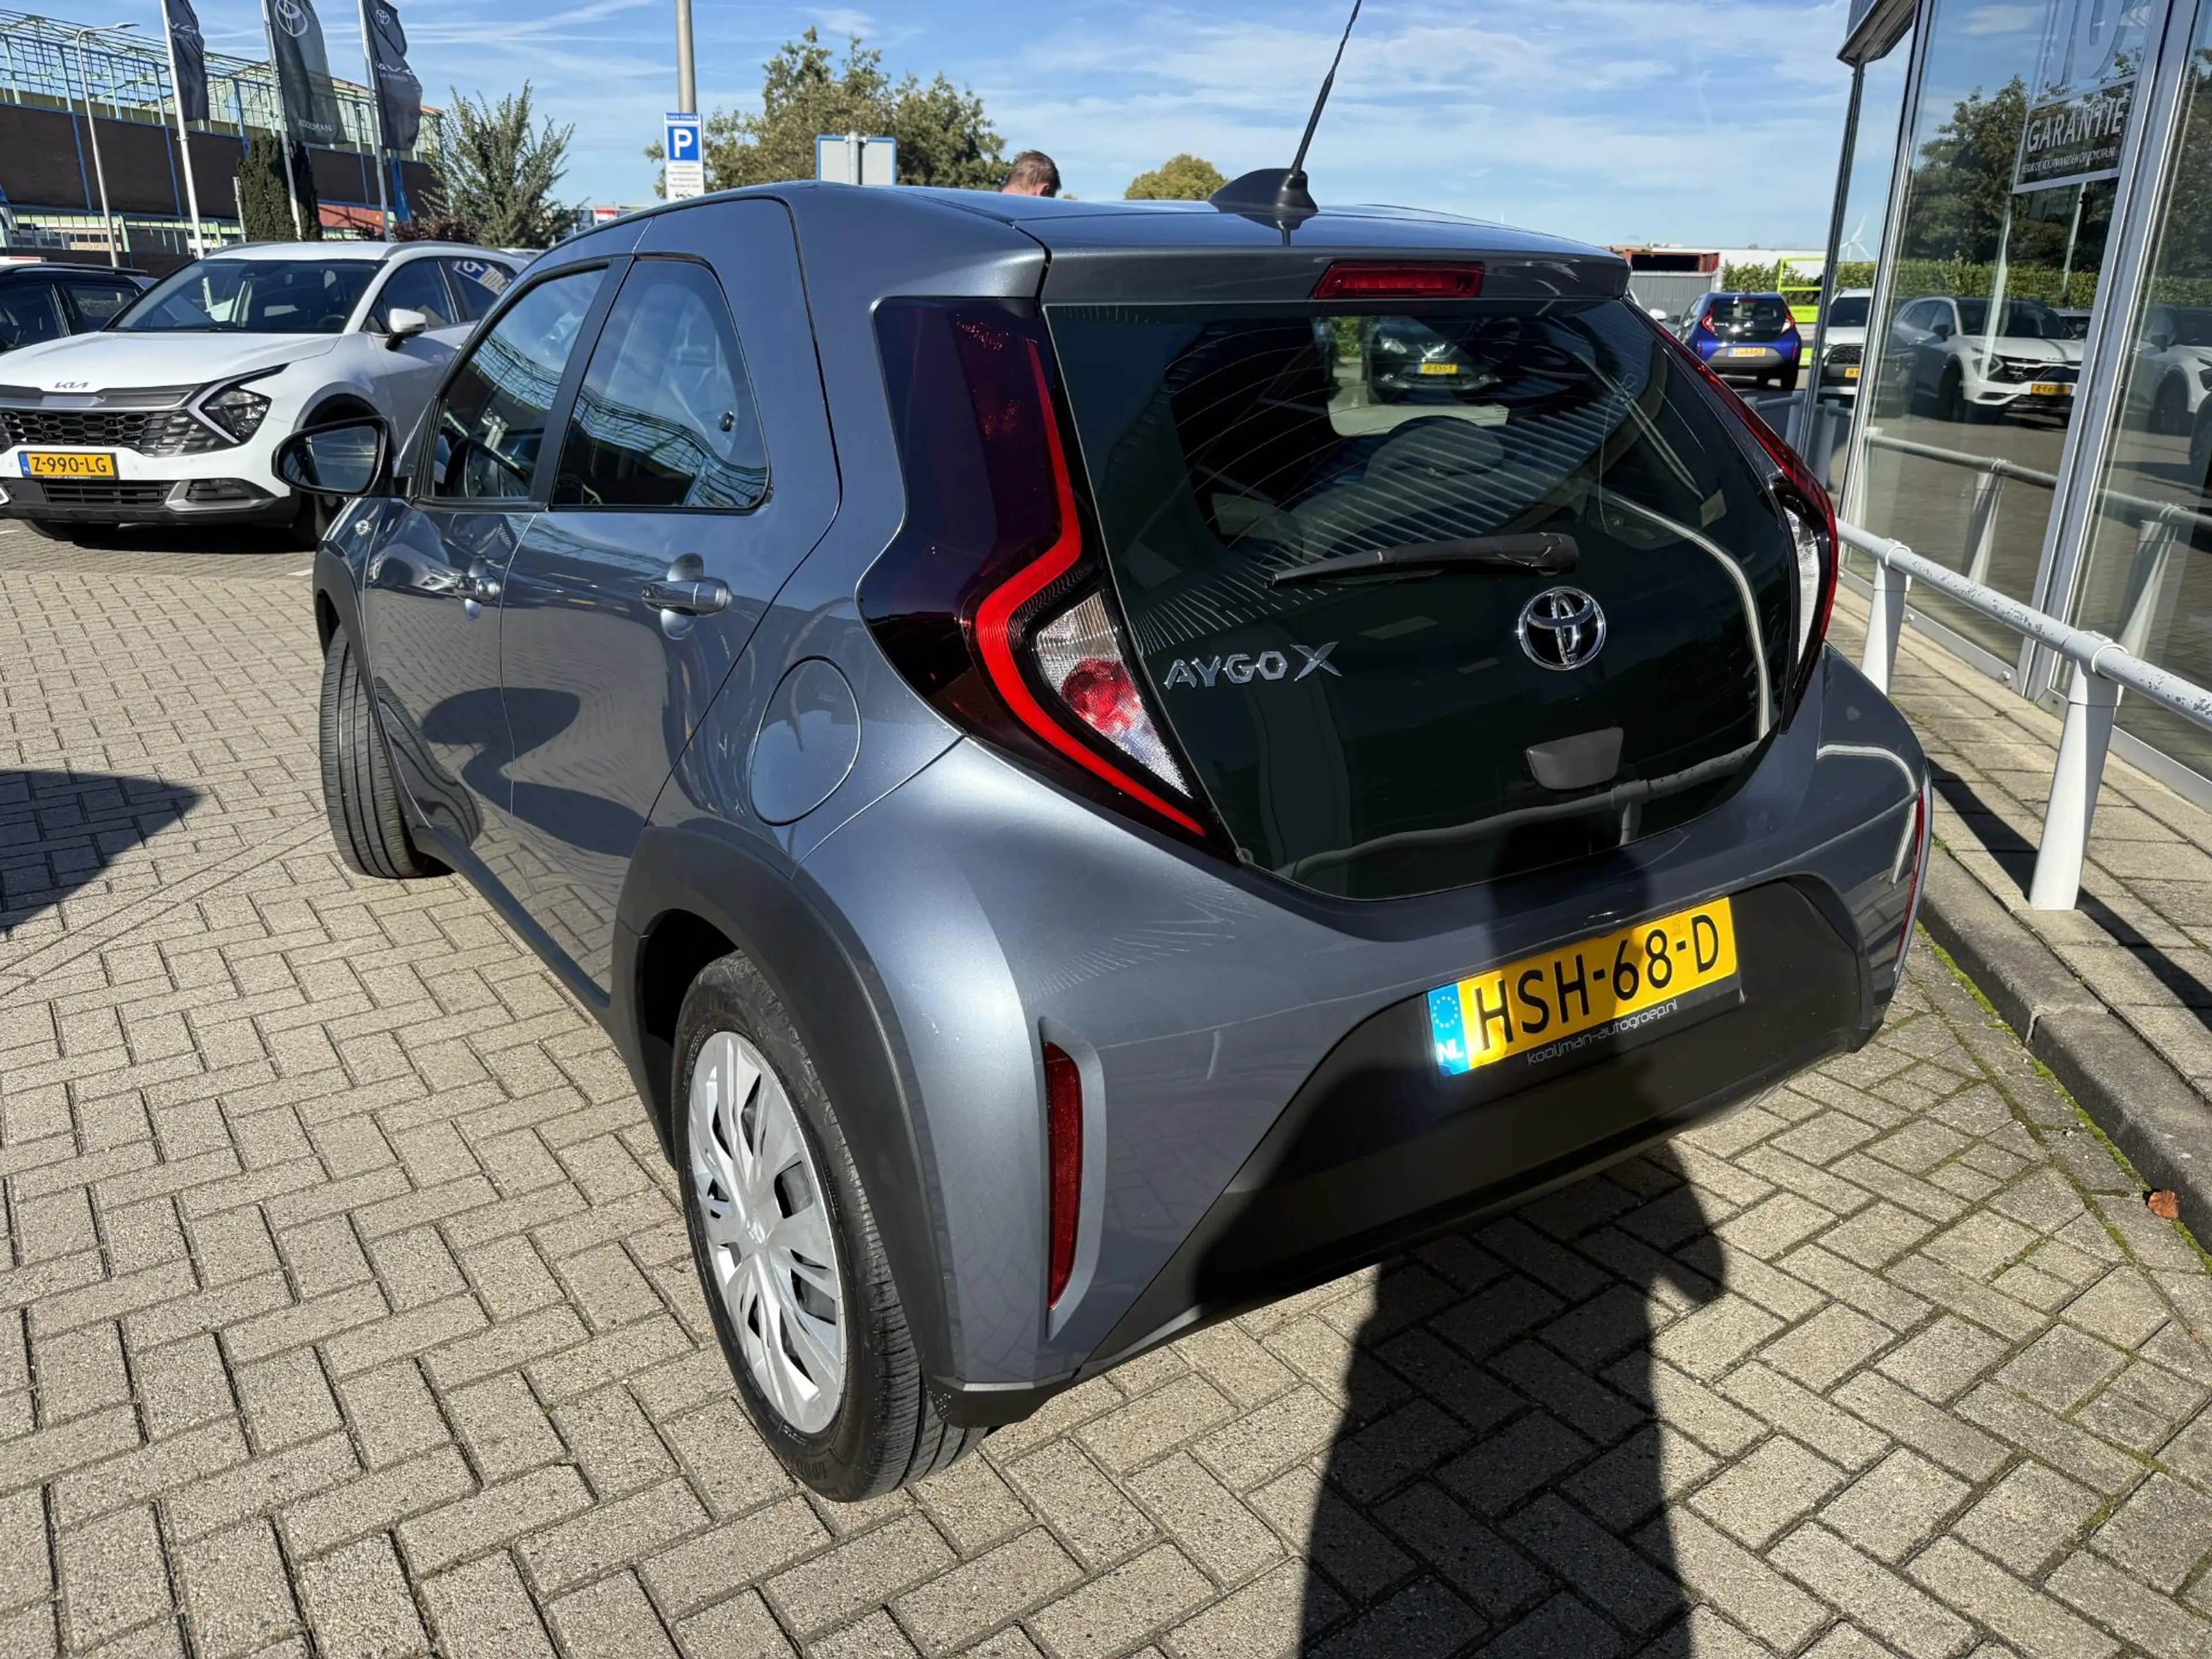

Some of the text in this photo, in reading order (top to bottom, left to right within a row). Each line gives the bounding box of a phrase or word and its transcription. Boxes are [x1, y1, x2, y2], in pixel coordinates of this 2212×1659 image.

[673, 128, 692, 158] P
[2027, 98, 2126, 153] GARANTIE
[32, 457, 107, 472] Z-990-LG
[1163, 641, 1343, 690] AYGO X
[1437, 914, 1719, 1061] NL HSH-68-D
[1527, 999, 1677, 1066] kooijman-autogroep.nl
